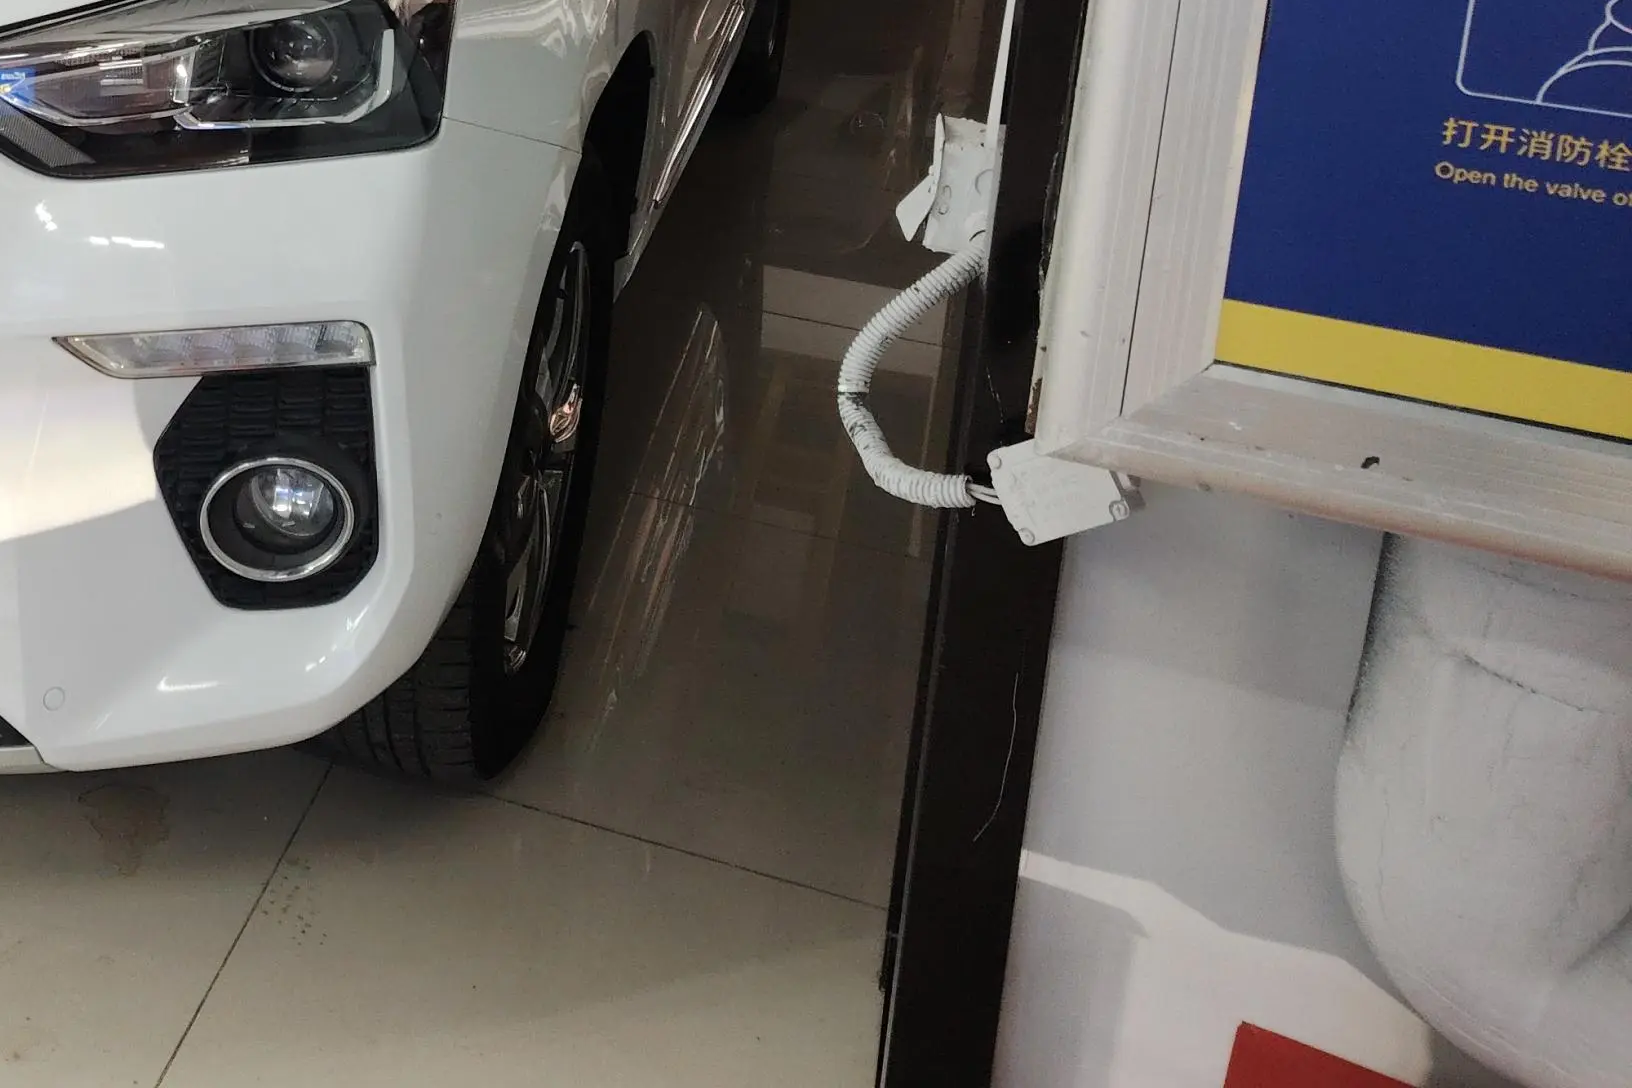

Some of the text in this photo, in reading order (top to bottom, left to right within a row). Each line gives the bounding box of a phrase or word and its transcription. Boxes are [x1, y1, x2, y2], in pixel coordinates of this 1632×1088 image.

[1442, 117, 1632, 172] 打开消防栓
[1435, 161, 1497, 186] Open
[1503, 172, 1539, 193] the
[1546, 181, 1607, 204] valve
